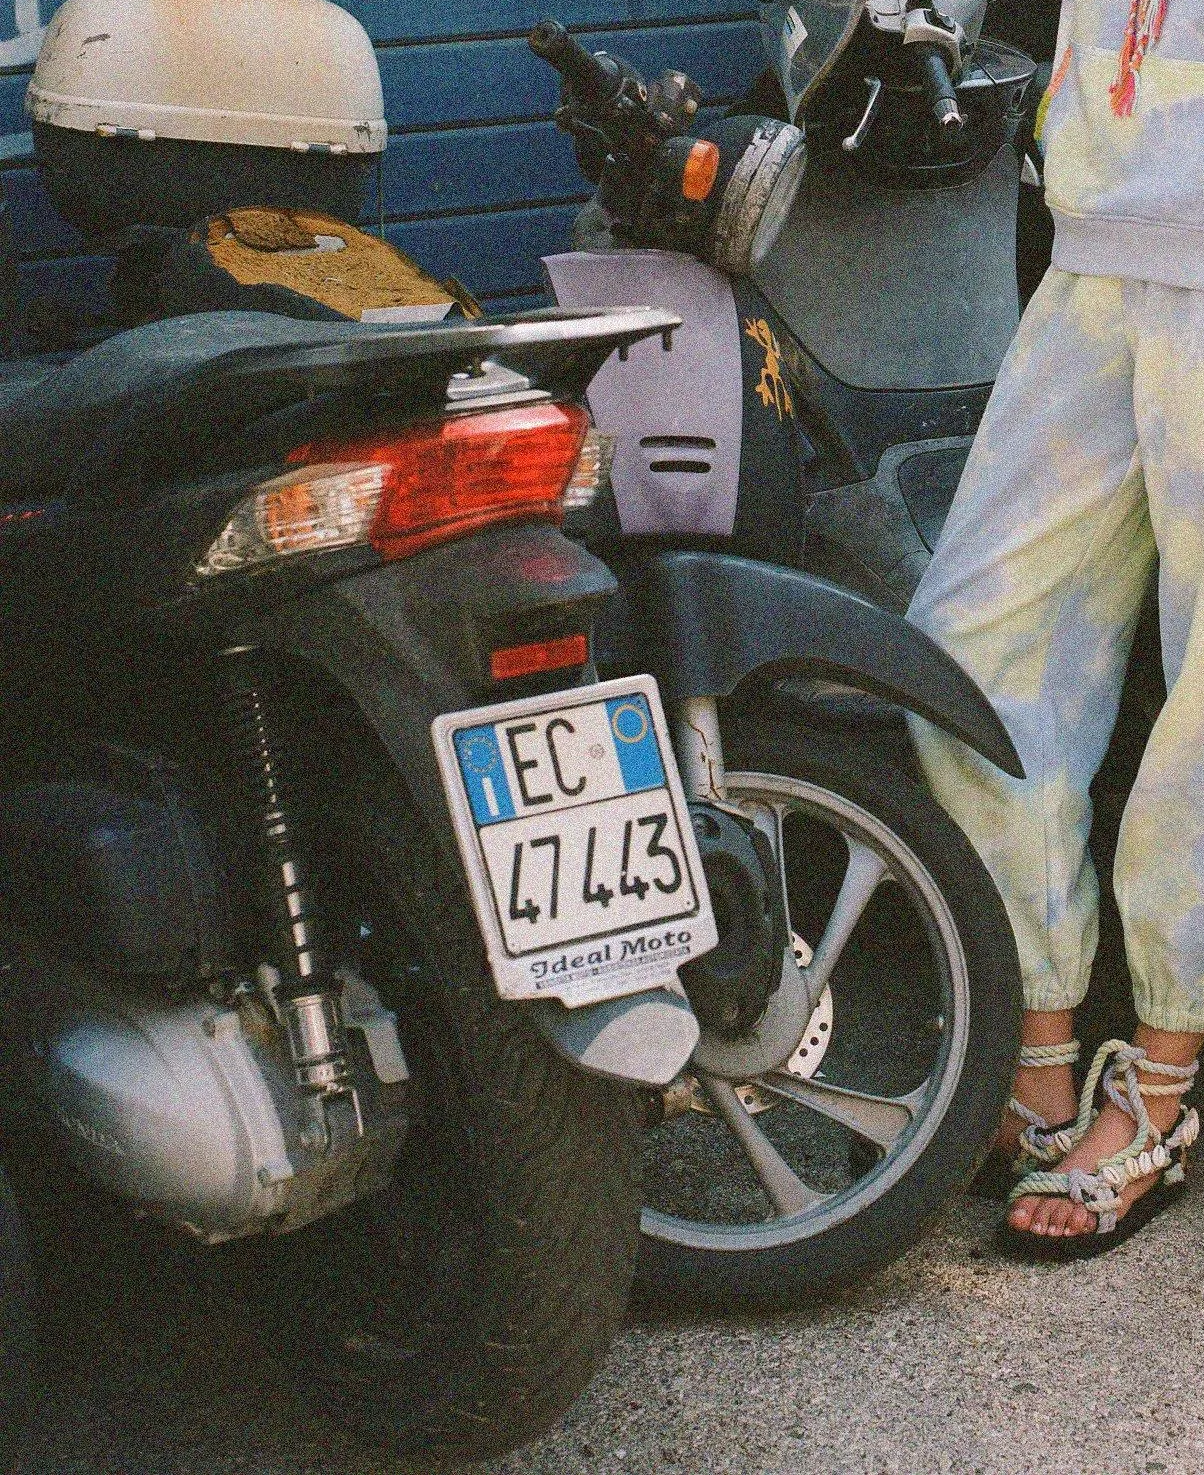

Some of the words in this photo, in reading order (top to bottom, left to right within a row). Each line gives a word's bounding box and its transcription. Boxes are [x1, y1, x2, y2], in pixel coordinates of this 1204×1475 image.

[506, 718, 587, 807] EC
[508, 812, 682, 924] 47443
[530, 944, 611, 979] Ideal
[619, 930, 692, 961] Moto
